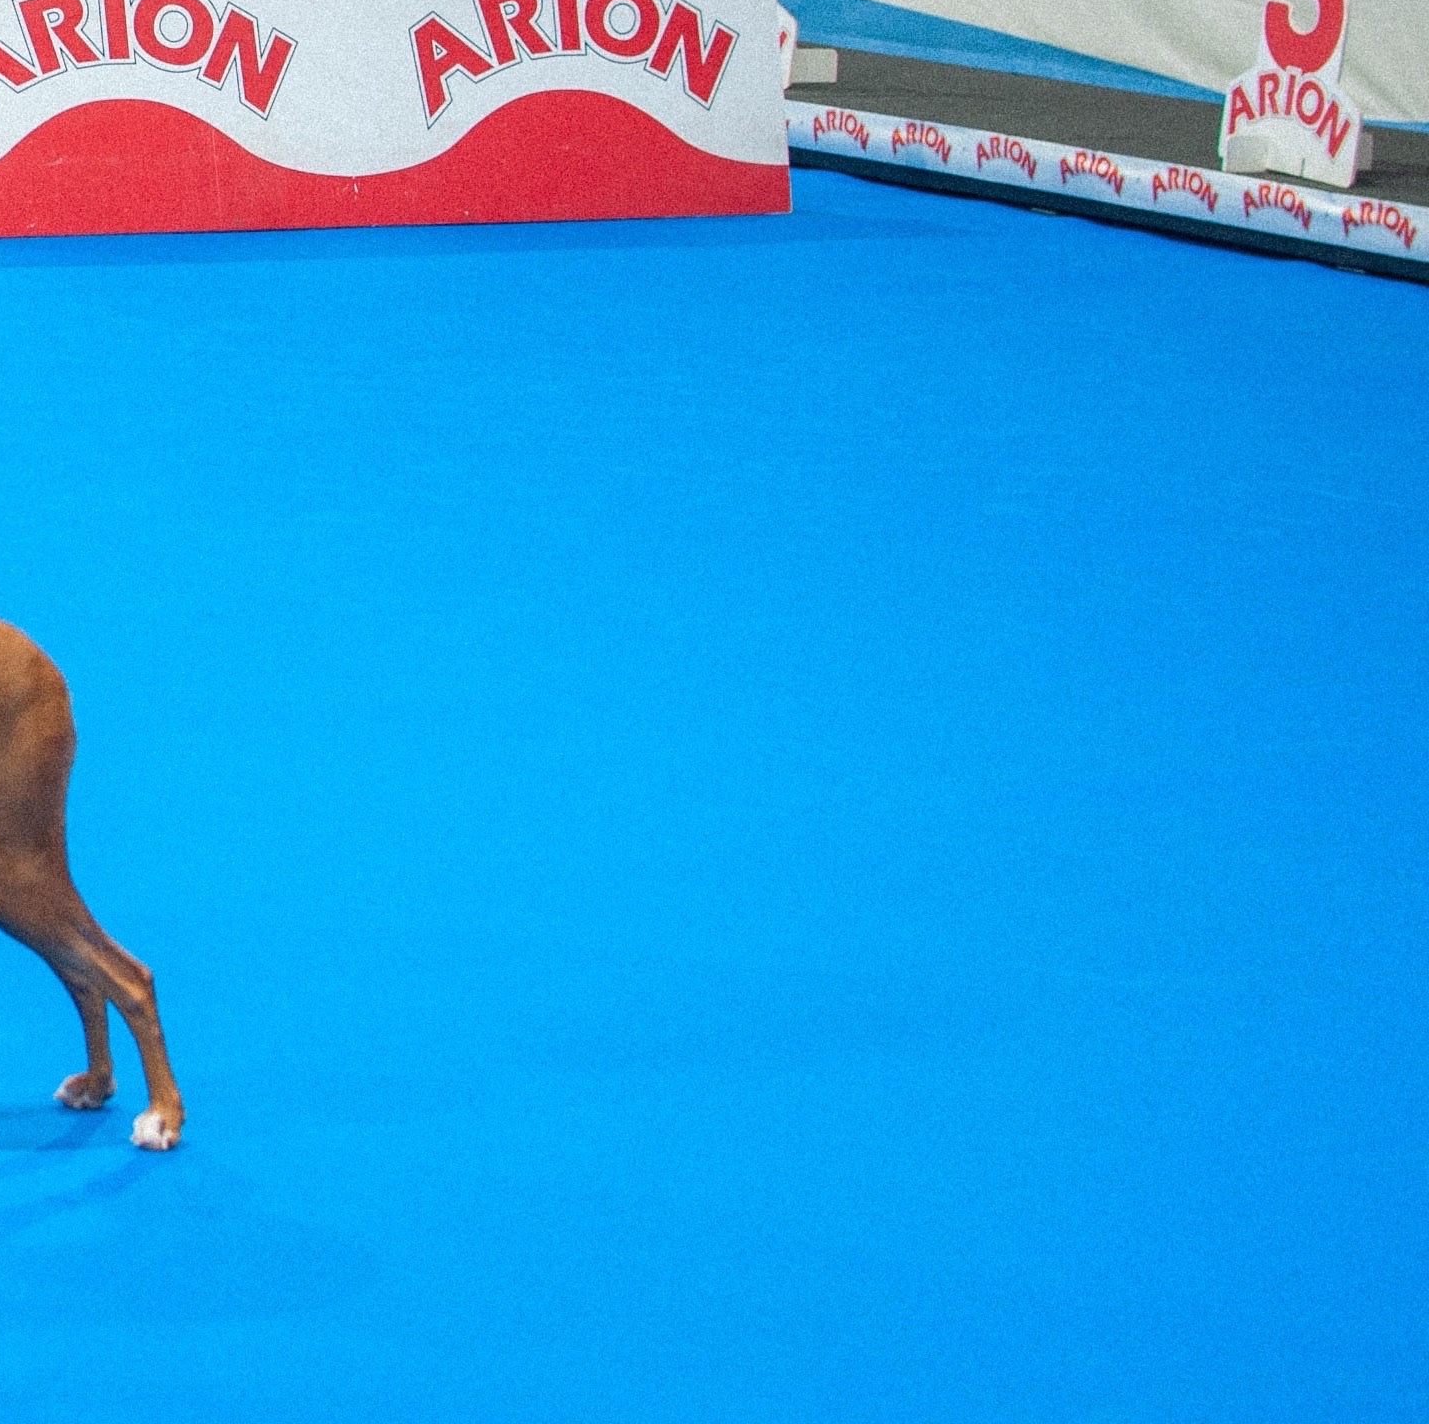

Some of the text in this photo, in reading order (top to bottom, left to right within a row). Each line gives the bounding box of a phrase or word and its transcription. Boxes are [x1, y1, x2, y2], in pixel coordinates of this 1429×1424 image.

[811, 107, 871, 152] ARION
[1226, 71, 1351, 160] ARION
[890, 121, 954, 164] ARION
[974, 133, 1038, 181] ARION
[1058, 150, 1126, 197] ARION
[1149, 166, 1220, 214] ARION
[1242, 182, 1313, 231] ARION
[1340, 200, 1418, 250] ARION
